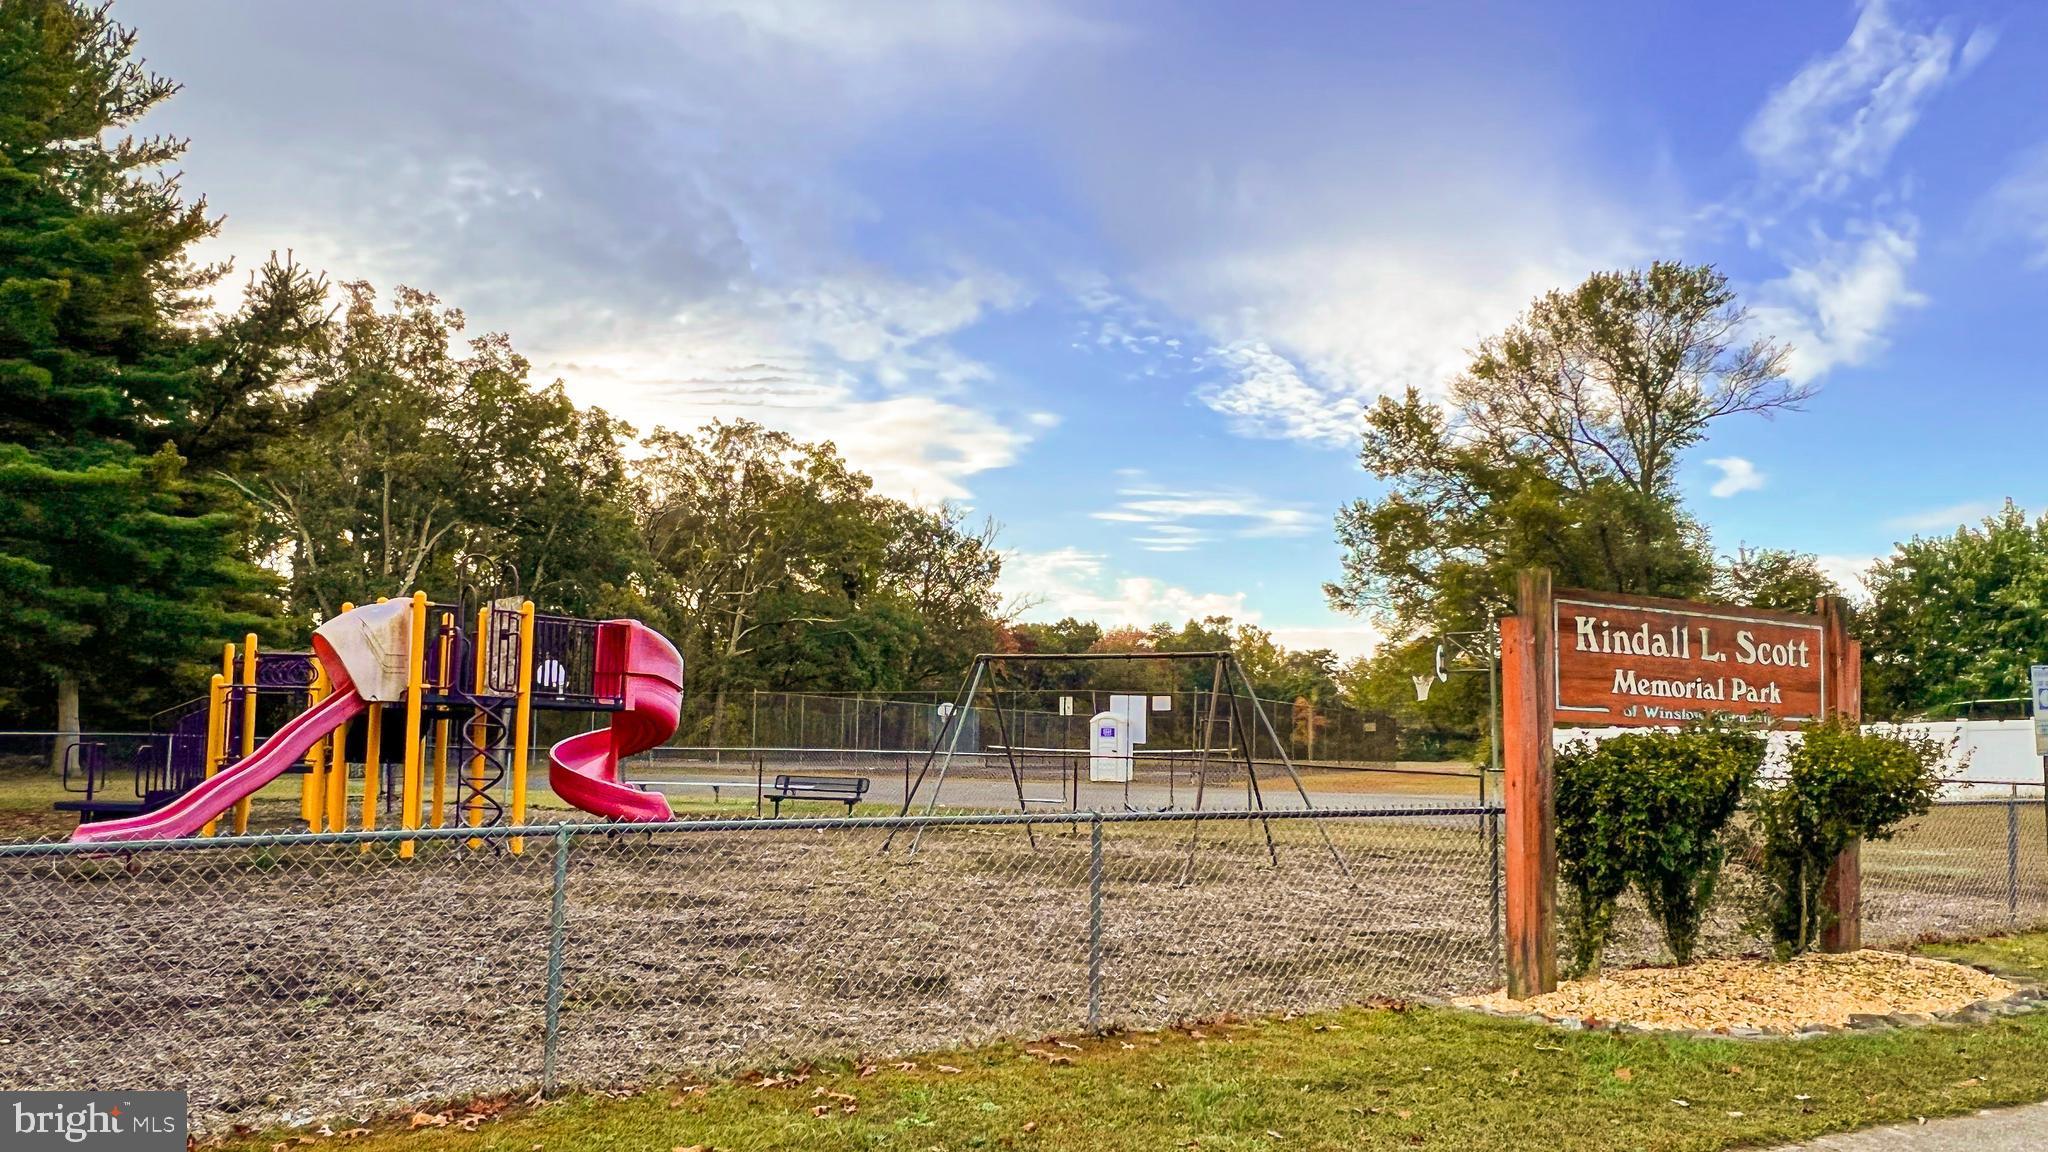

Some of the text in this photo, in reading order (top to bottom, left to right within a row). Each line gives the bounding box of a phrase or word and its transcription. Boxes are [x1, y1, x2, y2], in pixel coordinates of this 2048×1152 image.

[1574, 615, 1810, 668] Kindall L. Scott
[1611, 668, 1782, 704] Memorial Park
[1623, 704, 1638, 718] of
